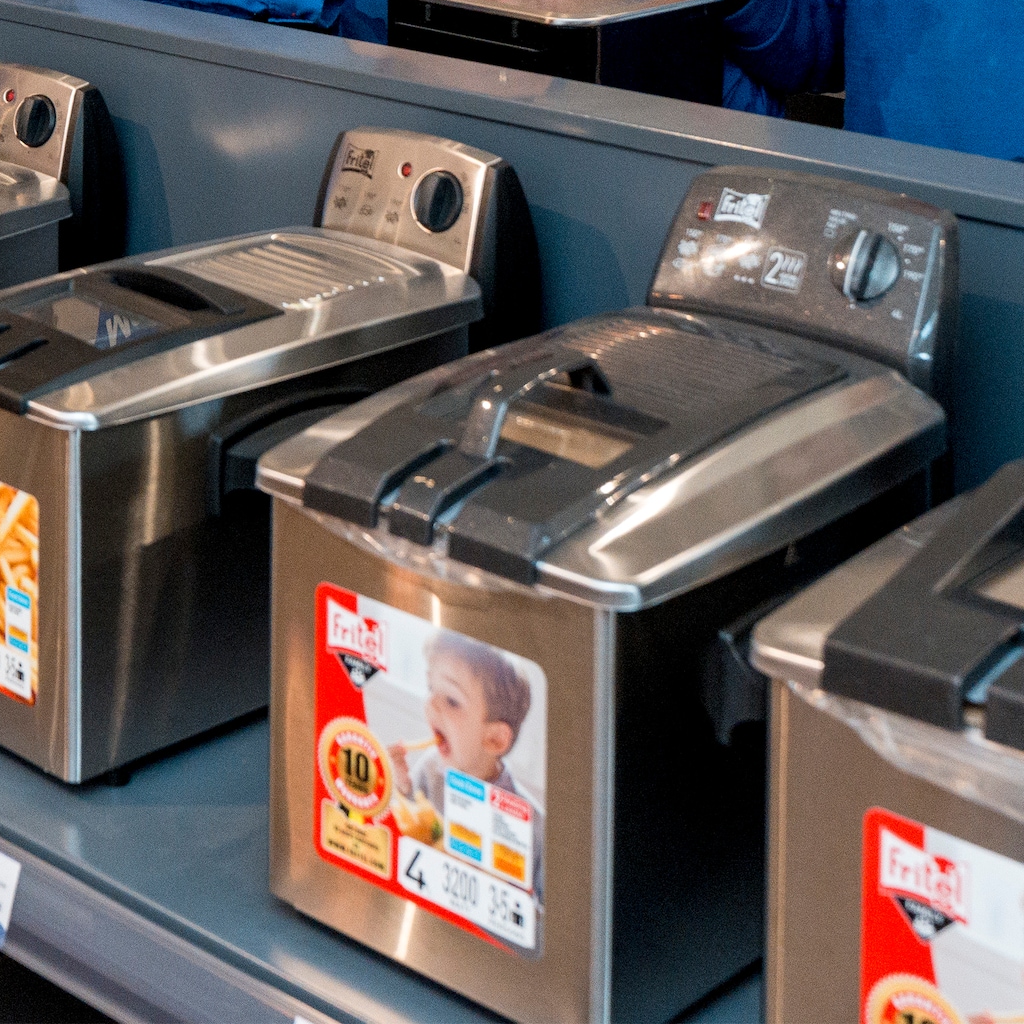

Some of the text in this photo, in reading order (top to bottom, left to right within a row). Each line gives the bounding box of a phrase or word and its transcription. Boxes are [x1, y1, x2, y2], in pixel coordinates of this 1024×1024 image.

[333, 613, 384, 656] Fritel
[343, 747, 369, 782] 10
[406, 849, 425, 890] 4
[442, 862, 478, 906] 3200
[890, 846, 963, 904] Fritel
